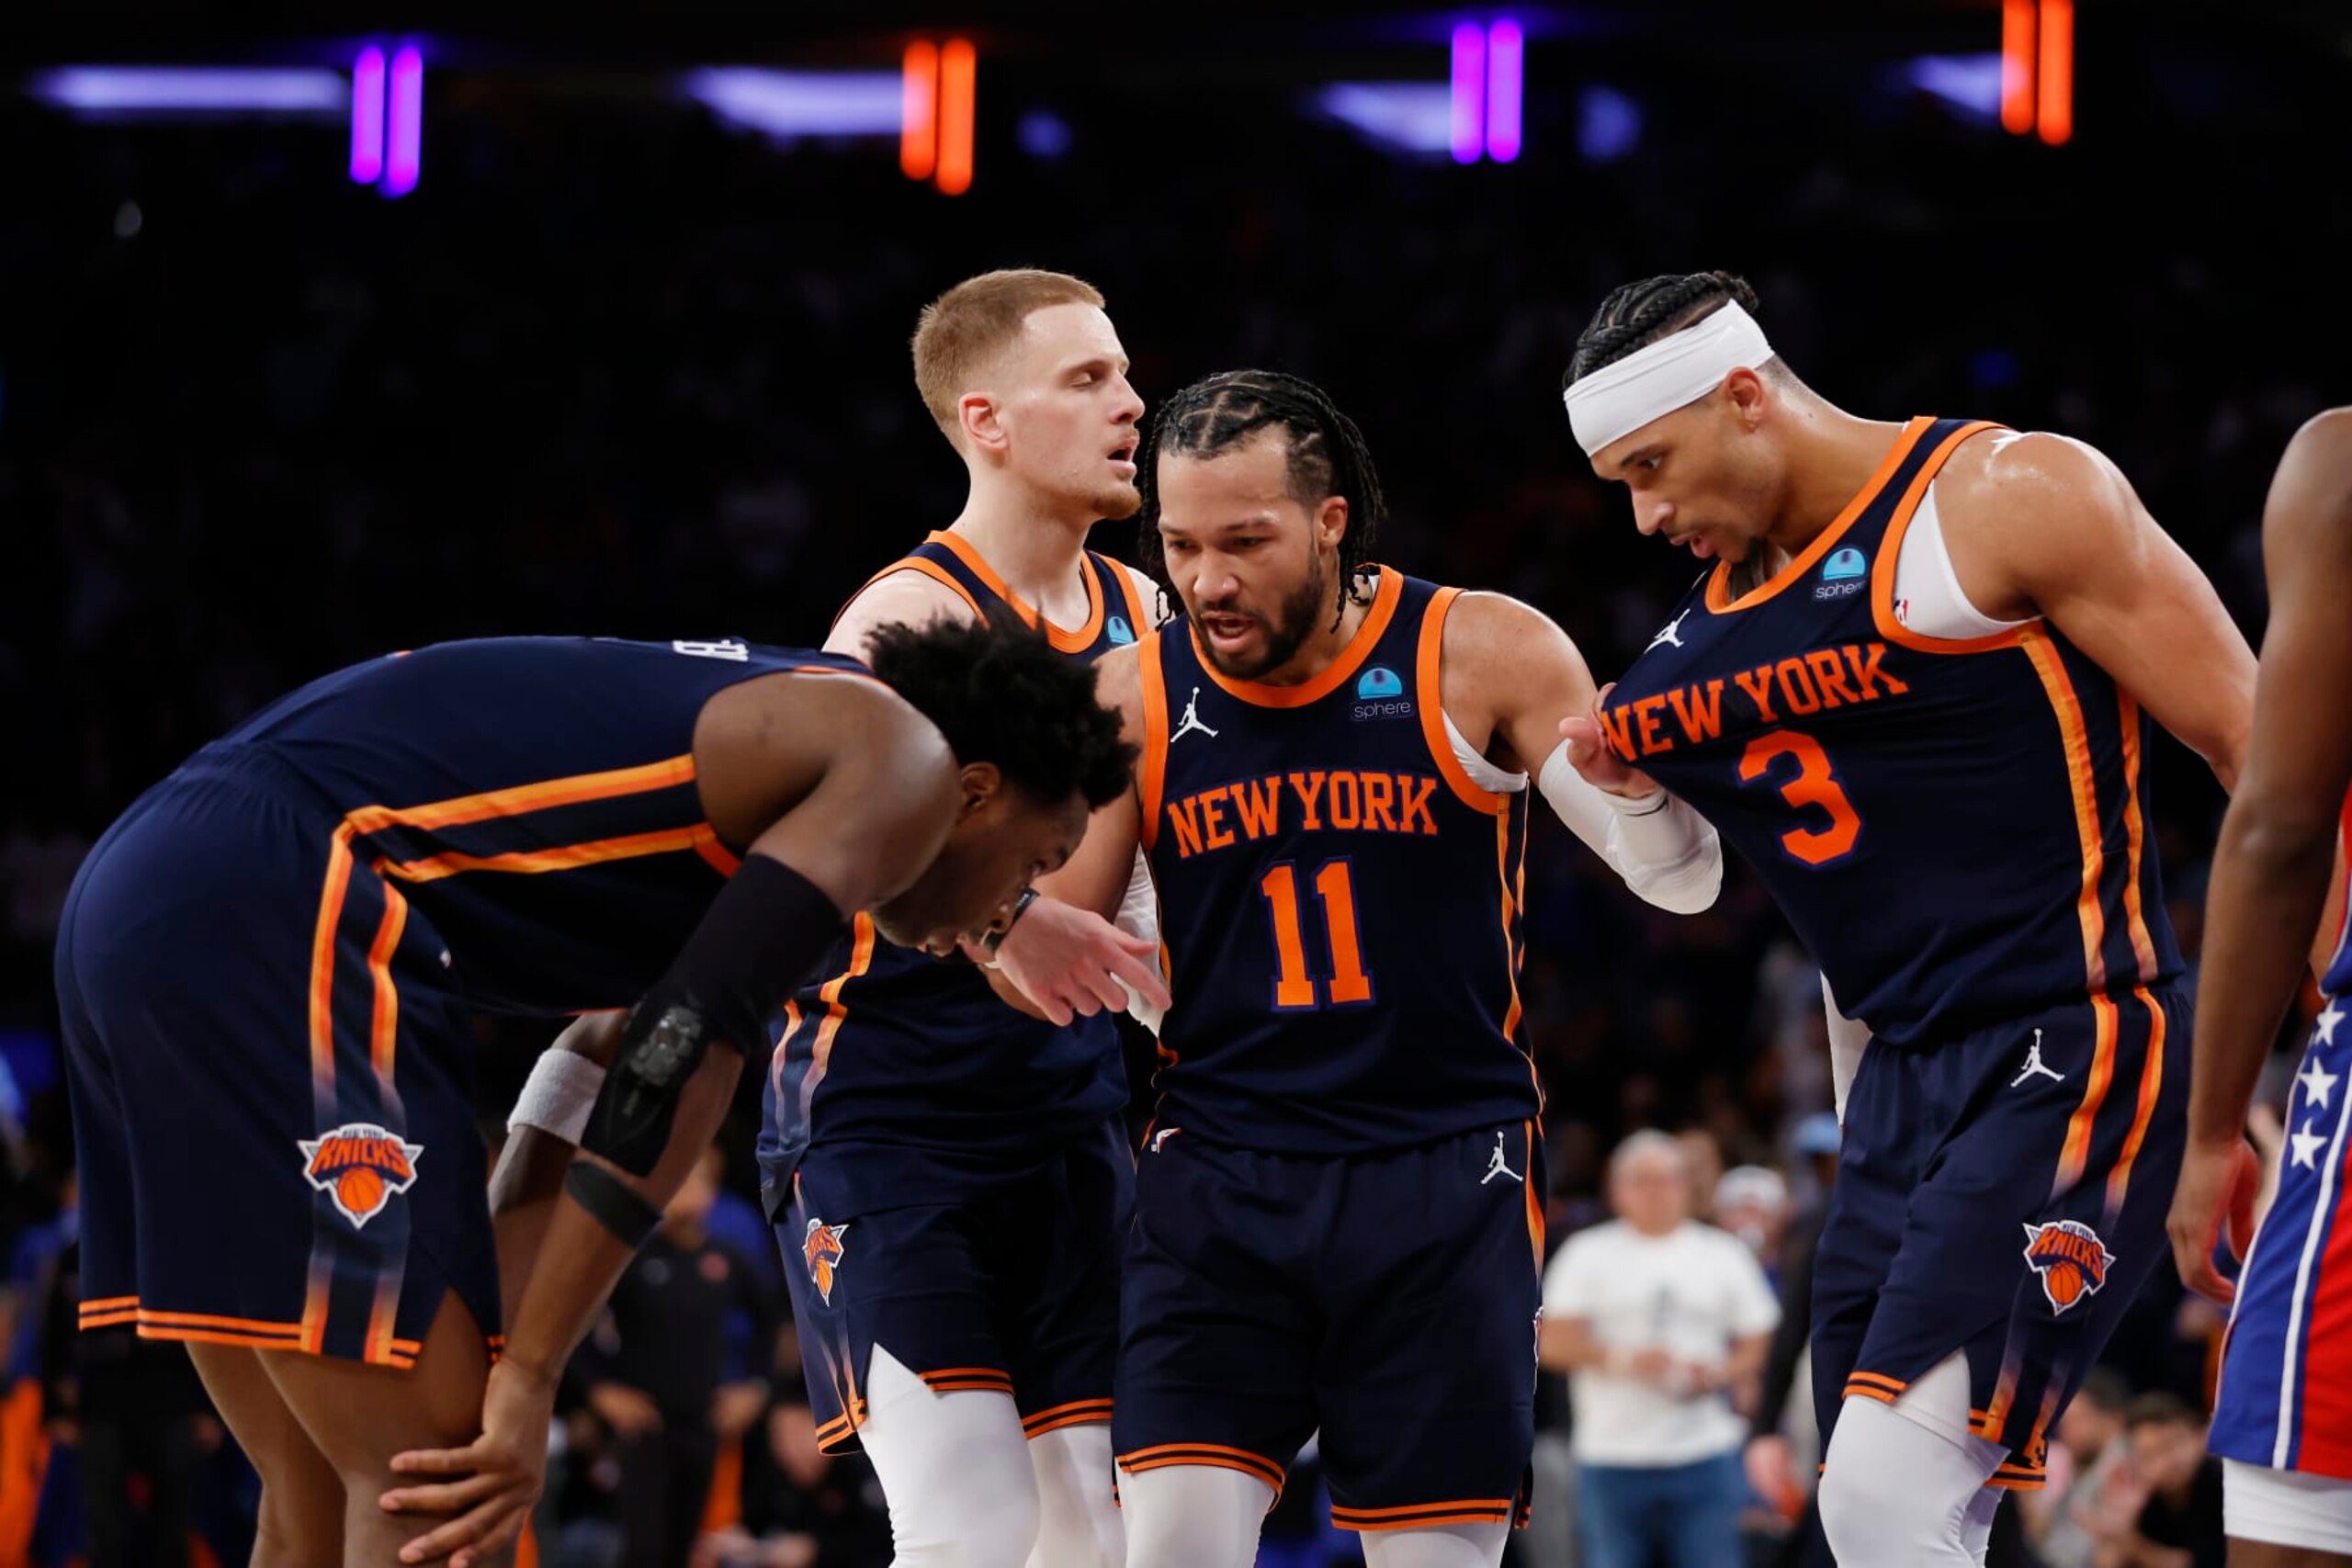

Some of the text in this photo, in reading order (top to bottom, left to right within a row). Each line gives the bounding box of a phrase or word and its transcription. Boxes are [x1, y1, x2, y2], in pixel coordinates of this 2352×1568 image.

[1353, 702, 1412, 720] sphere
[1600, 643, 1910, 762] NEW YORK
[1167, 771, 1439, 859] NEW YORK
[1738, 728, 1862, 866] 3
[1261, 861, 1373, 1008] 11
[310, 1137, 413, 1179] KNICKS
[2028, 1225, 2104, 1285] KNICKS
